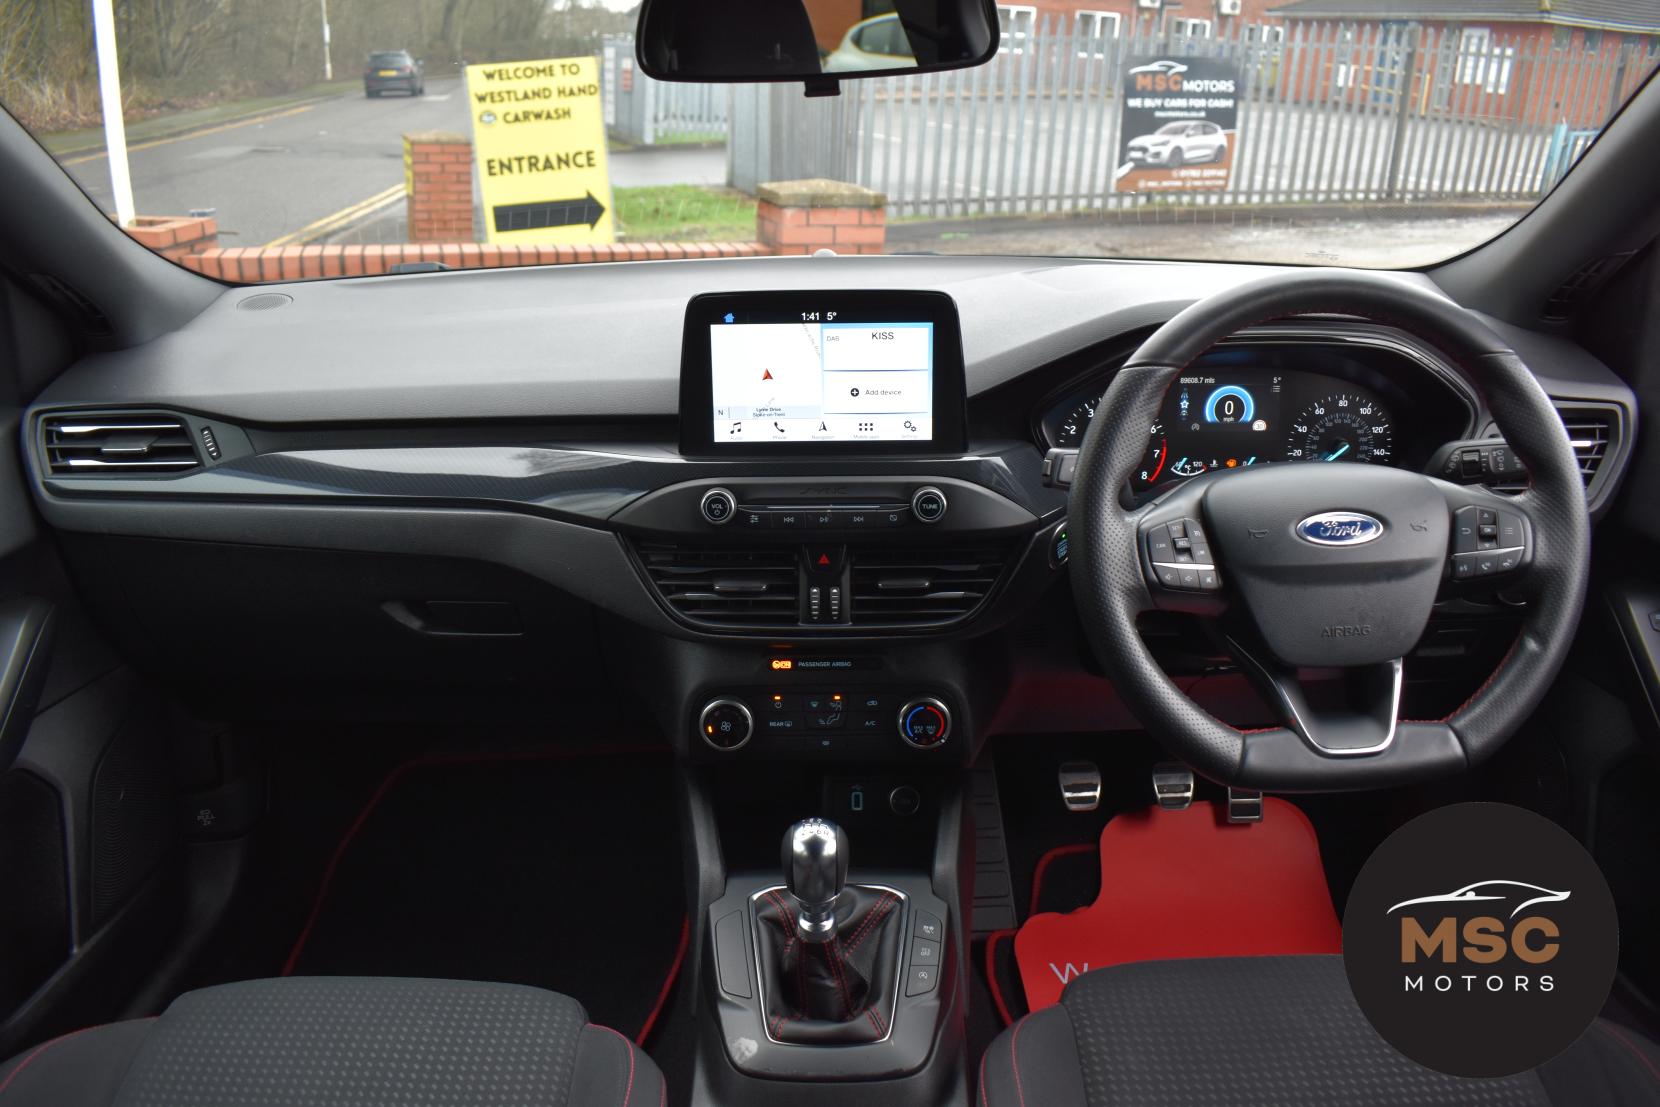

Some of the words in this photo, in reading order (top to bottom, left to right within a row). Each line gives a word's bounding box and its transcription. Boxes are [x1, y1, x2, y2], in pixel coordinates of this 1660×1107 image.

[482, 65, 555, 81] WELCOME
[560, 63, 580, 76] TO
[1182, 80, 1235, 92] MOTORS
[475, 87, 552, 103] WESTLAND
[557, 84, 598, 98] HAND
[1127, 98, 1142, 108] WE
[503, 108, 572, 124] CARWASH
[486, 151, 597, 176] ENTRANCE
[801, 312, 820, 321] 1:41
[871, 332, 894, 340] KISS
[1224, 400, 1234, 415] 0
[1087, 409, 1094, 418] 3
[1070, 426, 1077, 434] 2
[1150, 425, 1157, 434] 6
[1154, 449, 1160, 458] 7
[1141, 471, 1148, 480] 8
[1318, 519, 1363, 538] Ford
[1320, 625, 1372, 639] AIRBAG
